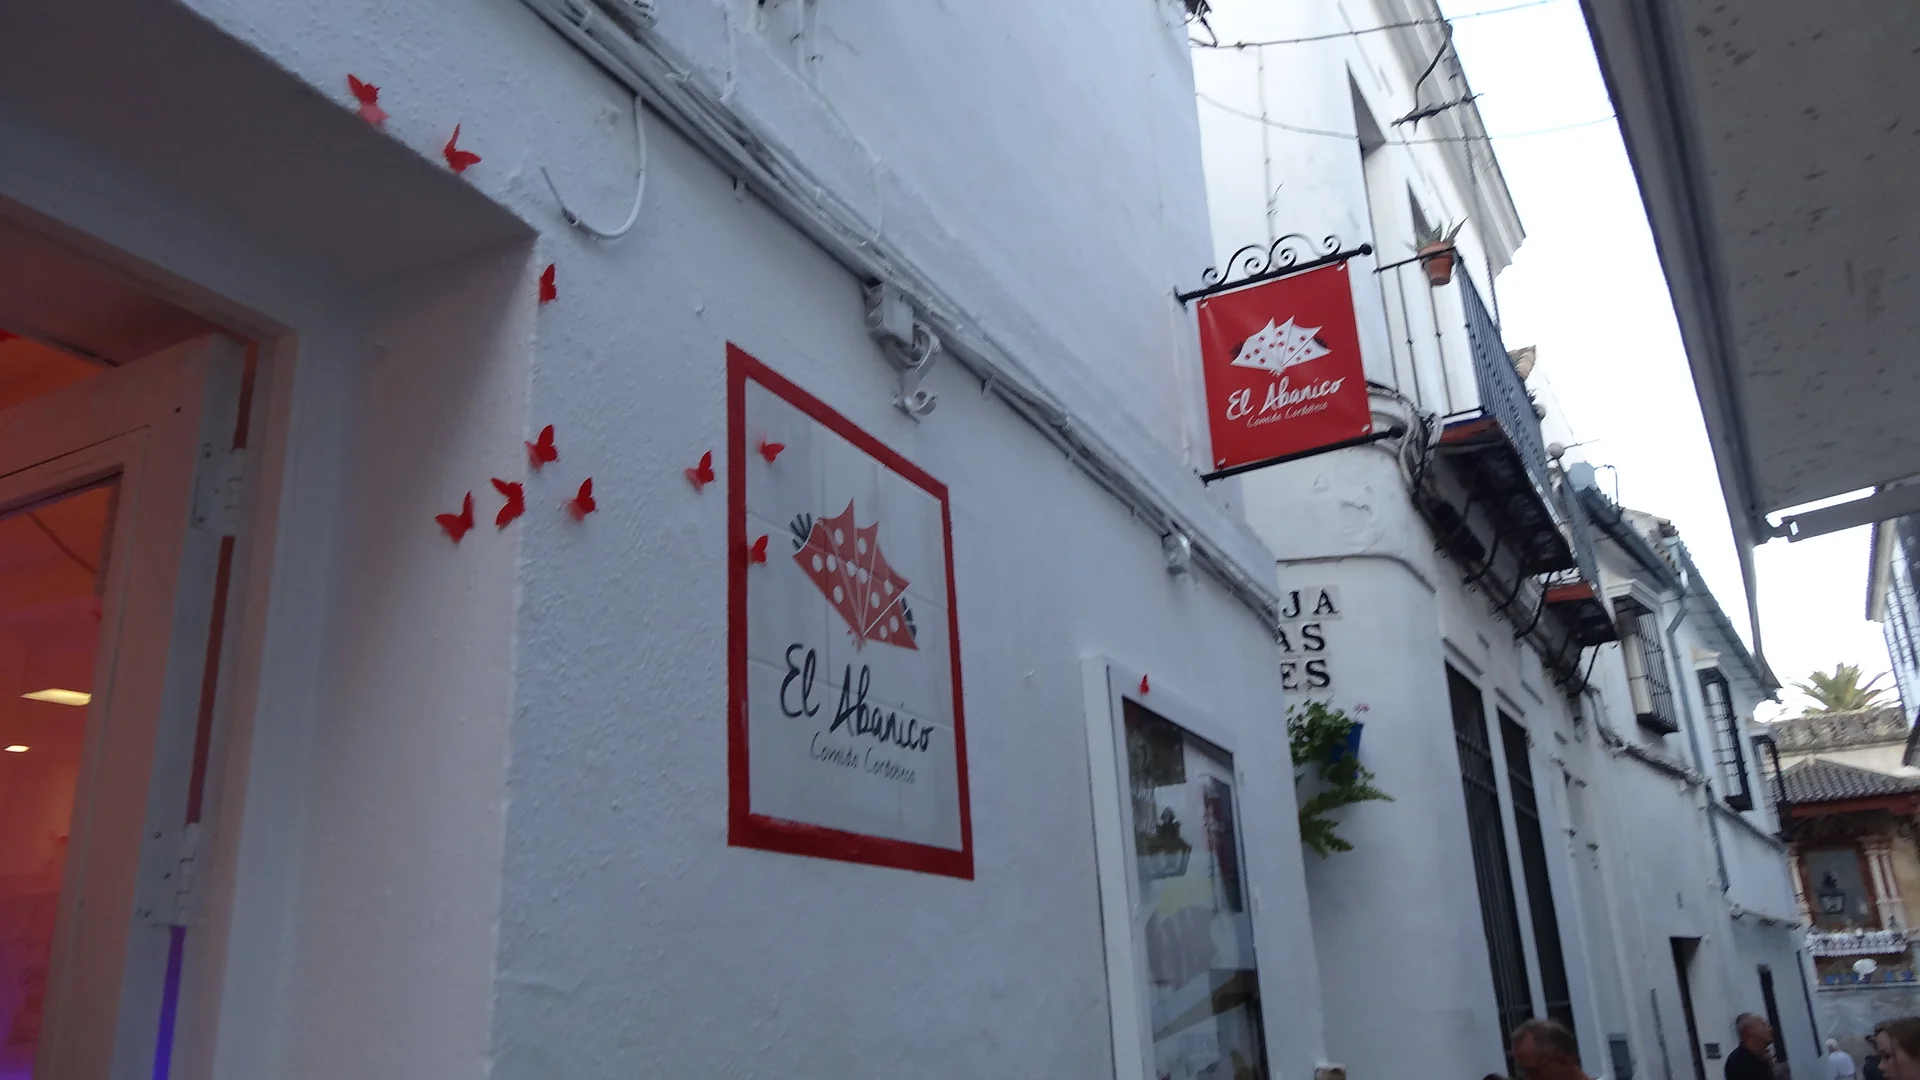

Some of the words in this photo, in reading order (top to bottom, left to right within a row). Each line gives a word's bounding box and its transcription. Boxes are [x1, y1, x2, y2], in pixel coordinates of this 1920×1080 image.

[1226, 387, 1254, 420] El
[1258, 376, 1346, 415] Abanico
[780, 643, 820, 718] El
[829, 663, 935, 752] Abanico
